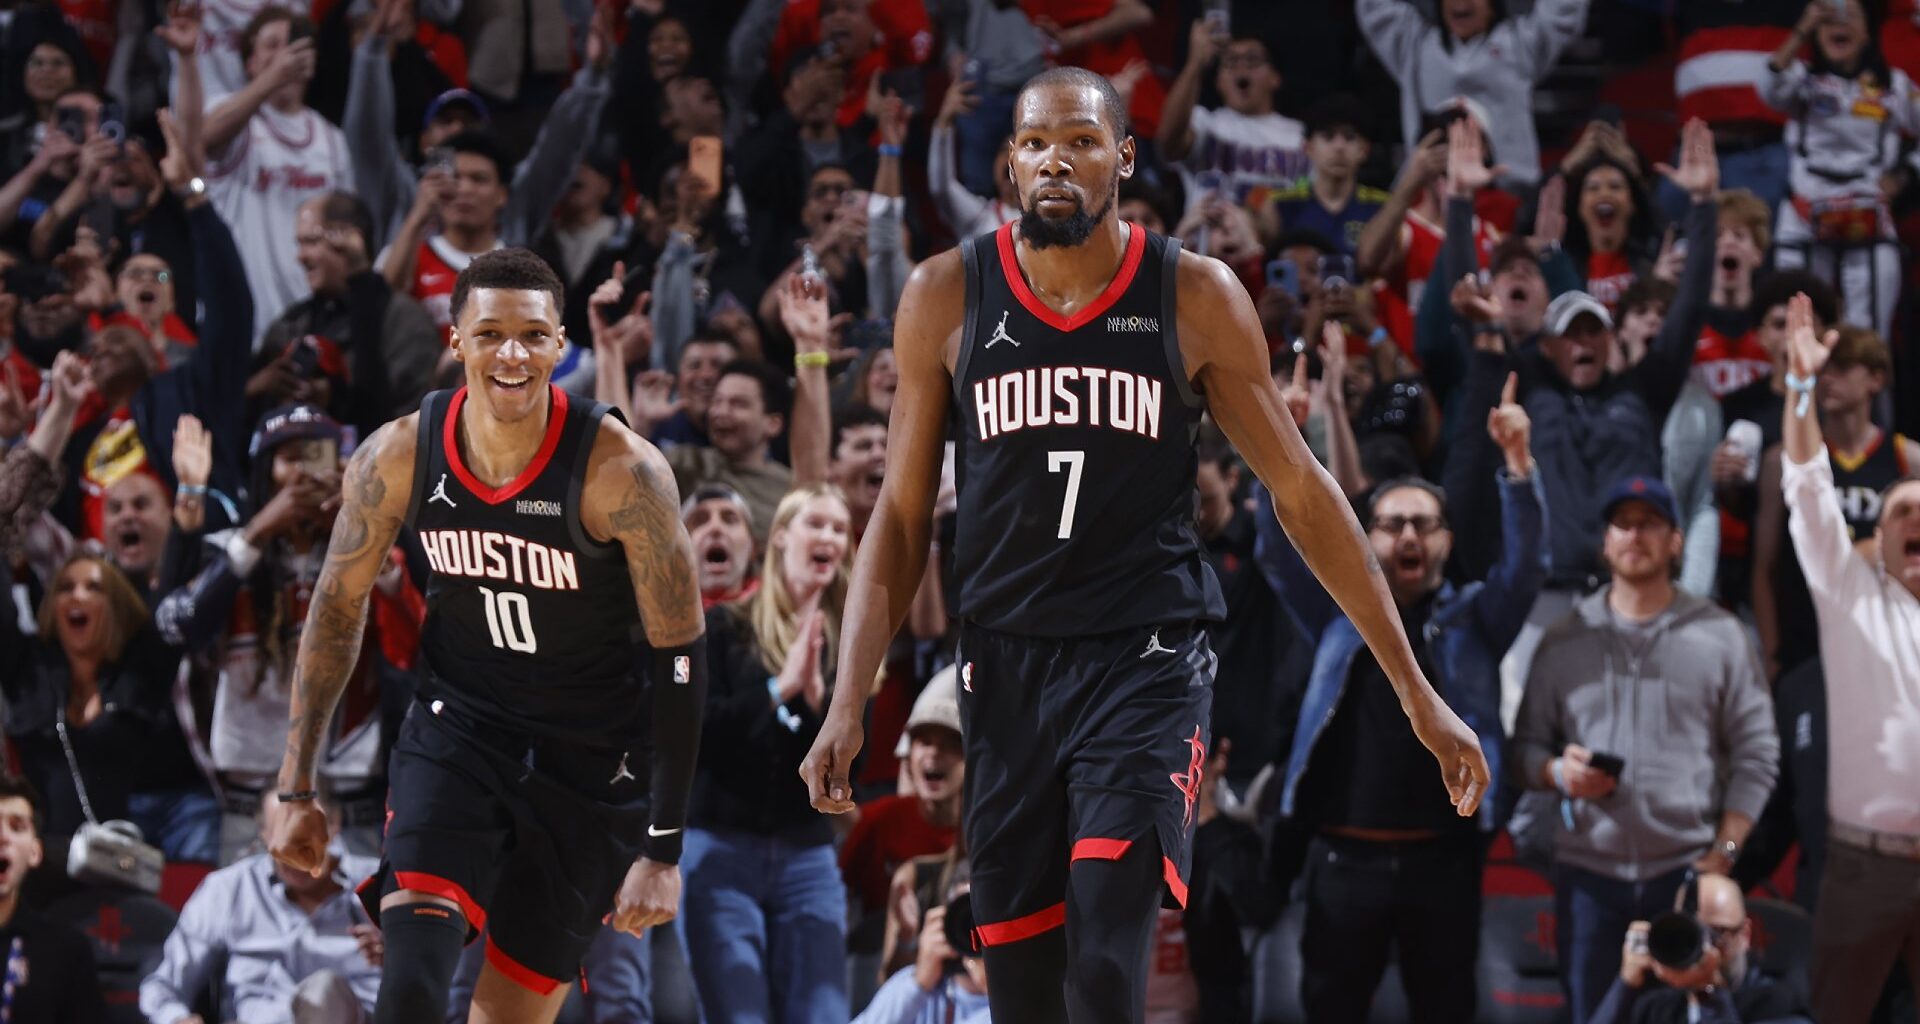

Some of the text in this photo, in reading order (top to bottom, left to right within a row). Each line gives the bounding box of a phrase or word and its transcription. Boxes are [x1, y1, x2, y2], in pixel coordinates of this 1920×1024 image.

[1107, 316, 1159, 326] MEMORIAL
[1107, 324, 1159, 334] HERMANN
[974, 366, 1162, 441] HOUSTON
[1047, 450, 1085, 539] 7
[418, 529, 579, 590] HOUSTON
[478, 585, 537, 654] 10
